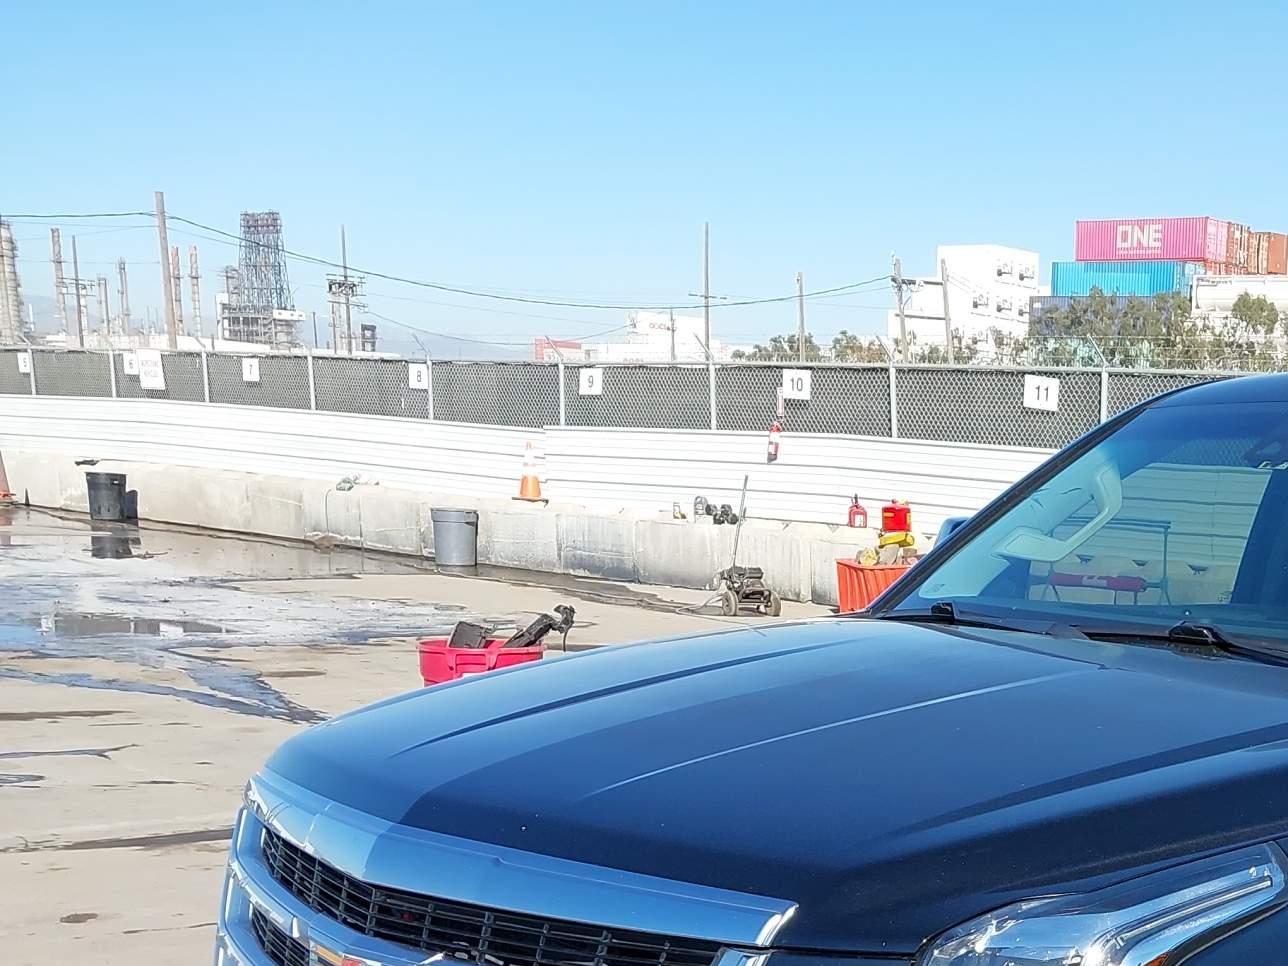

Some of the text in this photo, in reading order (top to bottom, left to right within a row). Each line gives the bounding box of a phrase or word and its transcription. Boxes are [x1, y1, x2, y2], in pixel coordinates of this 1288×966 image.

[1116, 224, 1163, 248] ONE
[416, 370, 422, 382] 8
[587, 375, 594, 388] 9
[790, 377, 804, 392] 10
[1035, 385, 1049, 402] 11
